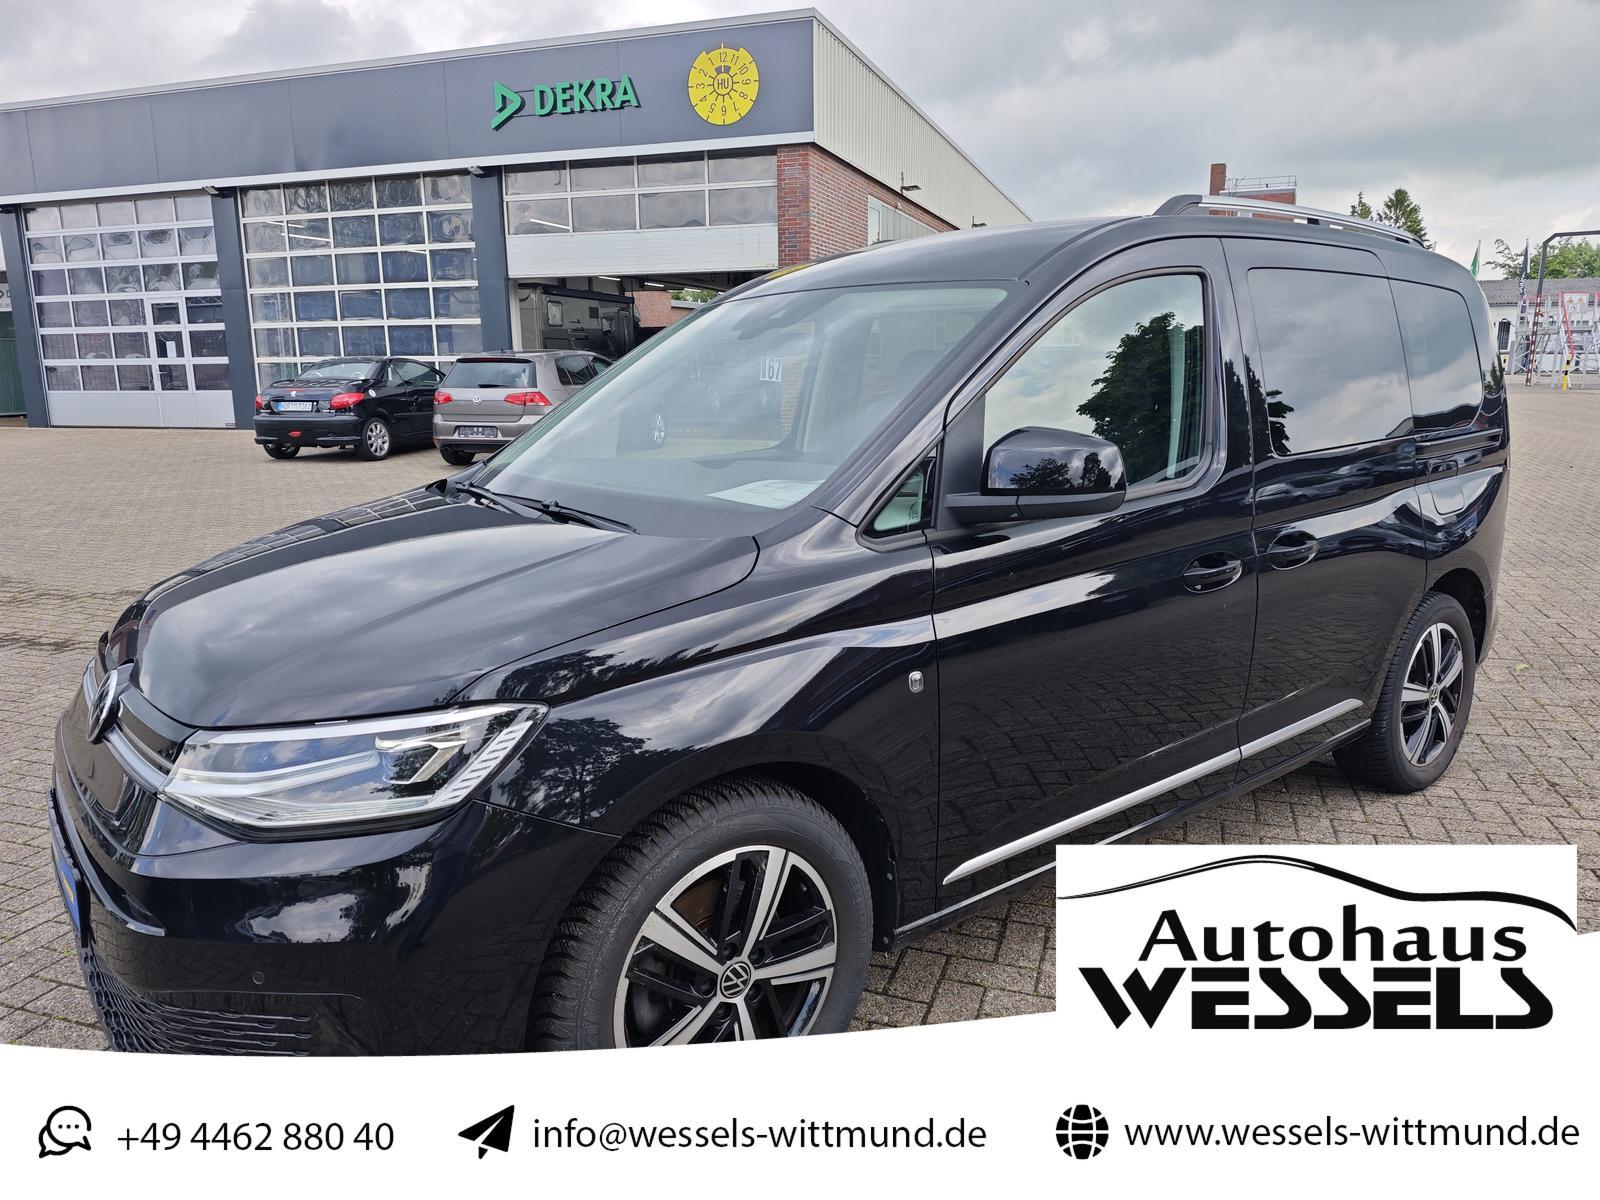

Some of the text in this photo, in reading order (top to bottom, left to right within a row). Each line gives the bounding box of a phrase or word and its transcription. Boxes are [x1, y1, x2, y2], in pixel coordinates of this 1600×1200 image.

[708, 57, 714, 66] 1
[720, 52, 727, 63] 12
[730, 54, 739, 66] 11
[698, 68, 708, 77] 2
[738, 63, 749, 75] 10
[717, 78, 729, 90] HU
[534, 74, 640, 116] DEKRA
[739, 91, 748, 100] 8
[709, 102, 716, 113] 5
[721, 105, 727, 116] 6
[733, 101, 739, 112] 7
